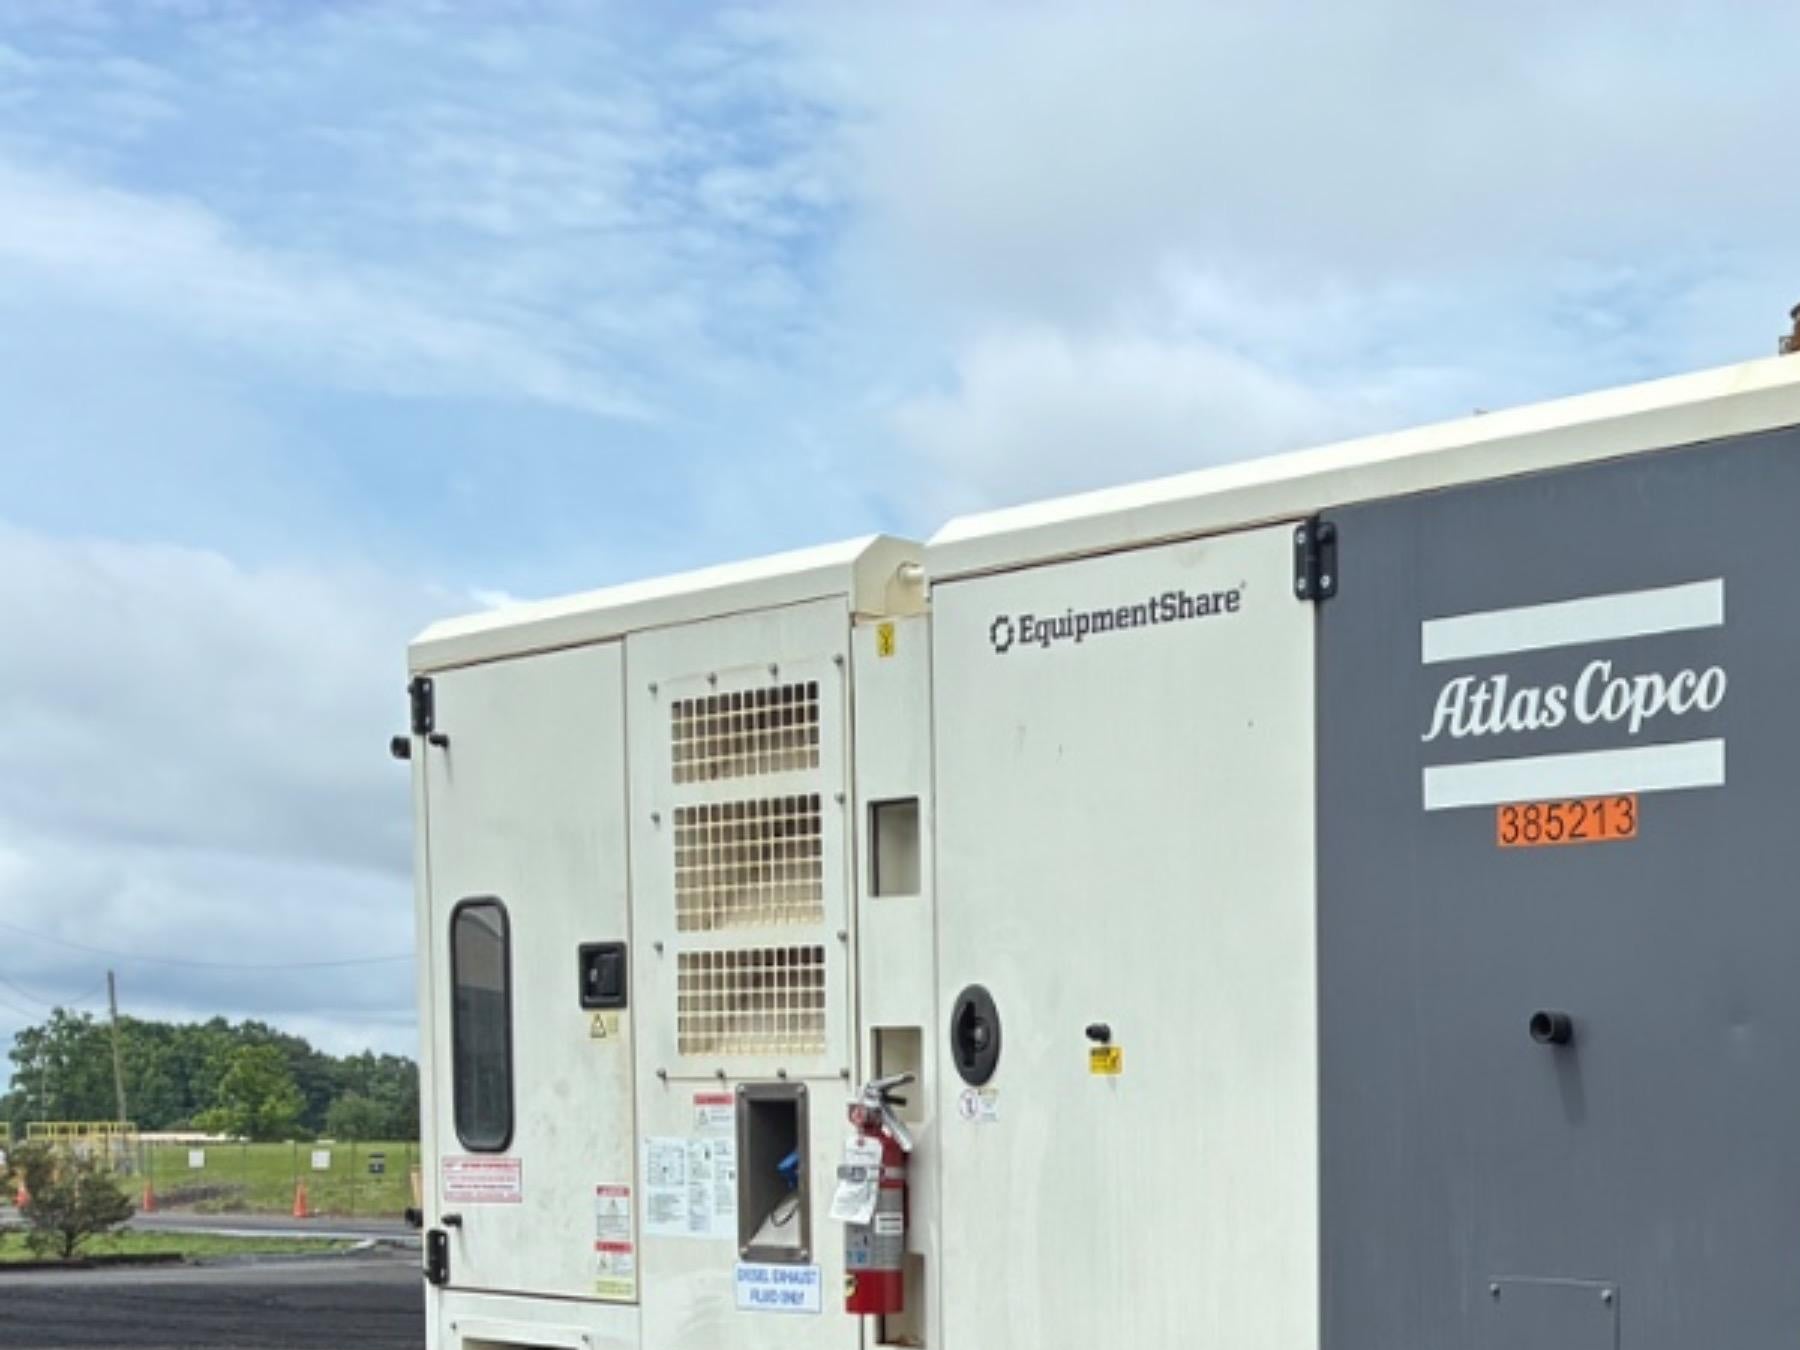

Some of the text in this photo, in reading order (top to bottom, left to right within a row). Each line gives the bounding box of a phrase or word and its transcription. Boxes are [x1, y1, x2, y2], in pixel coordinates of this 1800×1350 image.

[1018, 588, 1241, 648] EquipmentShare
[1421, 659, 1727, 742] Atlas Copco
[1501, 796, 1635, 844] 385213
